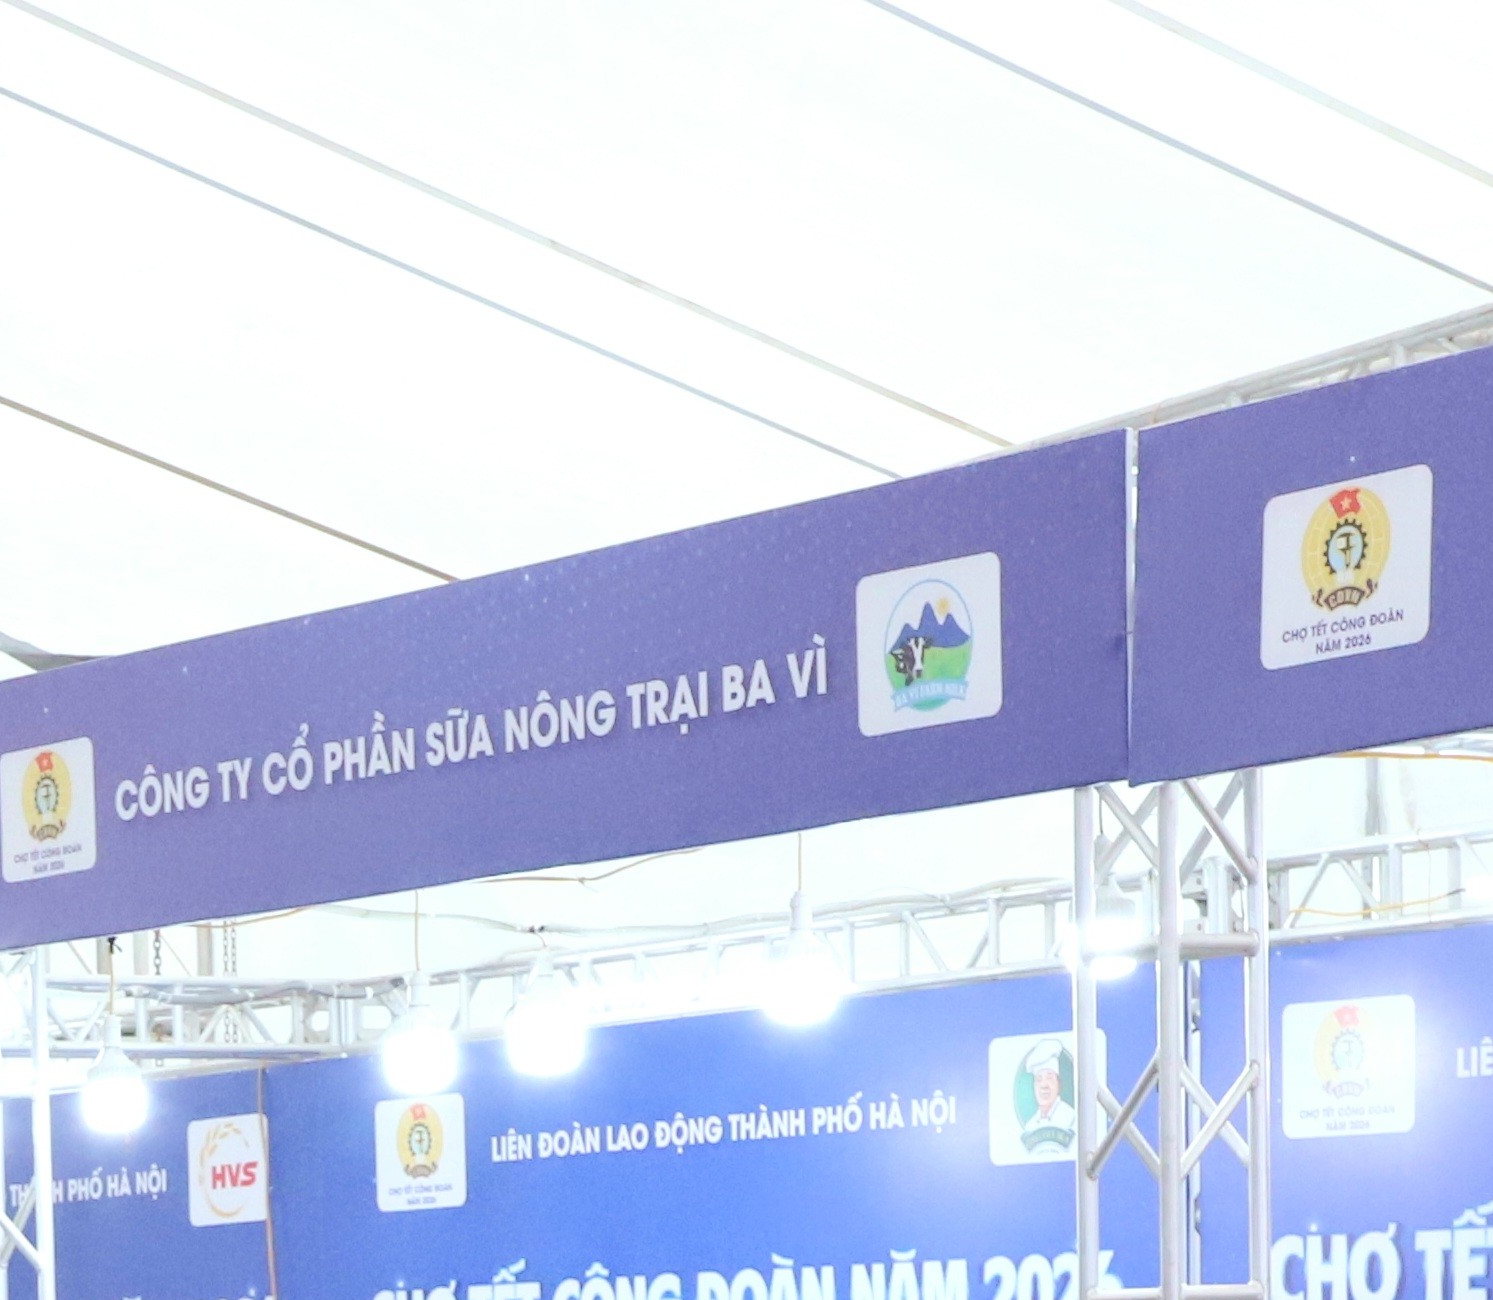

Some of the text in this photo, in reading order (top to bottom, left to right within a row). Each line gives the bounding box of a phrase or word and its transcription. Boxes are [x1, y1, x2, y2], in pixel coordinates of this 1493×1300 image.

[1330, 616, 1366, 634] CÔNG
[1315, 633, 1372, 654] NĂM 2026
[115, 634, 828, 822] CÔNG TY CỔ PHẦN SỮA NÔNG TRẠI BA VÌ
[491, 1089, 957, 1163] LIÊN ĐOÀN LAO ĐỘNG THÀNH PHỐ HÀ NỘI
[67, 1167, 103, 1202] PHỐ
[106, 1167, 133, 1199] HÀ
[135, 1164, 168, 1201] NỘI
[211, 1161, 259, 1189] HVS
